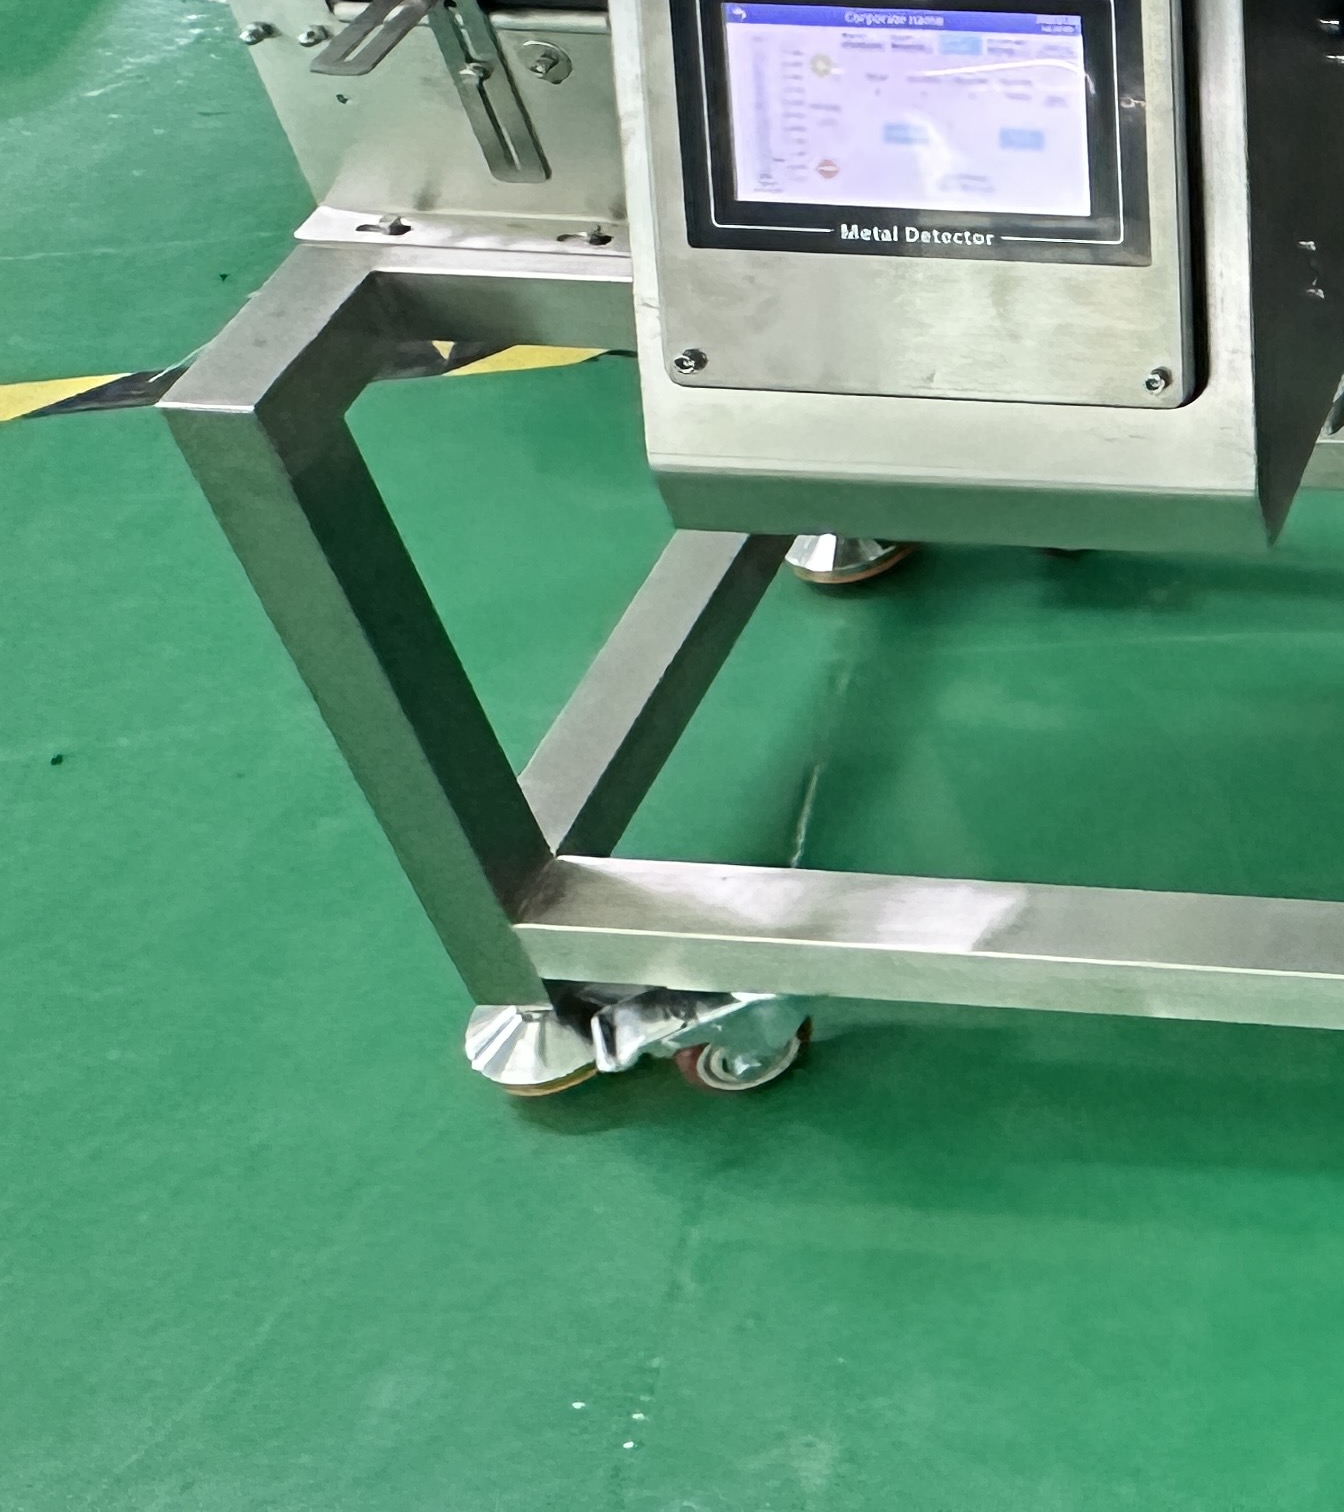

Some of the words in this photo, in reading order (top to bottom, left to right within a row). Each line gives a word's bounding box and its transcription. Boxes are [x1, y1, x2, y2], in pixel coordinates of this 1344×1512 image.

[844, 10, 907, 26] Corporate
[840, 223, 899, 242] Metal
[904, 226, 995, 246] Detector
